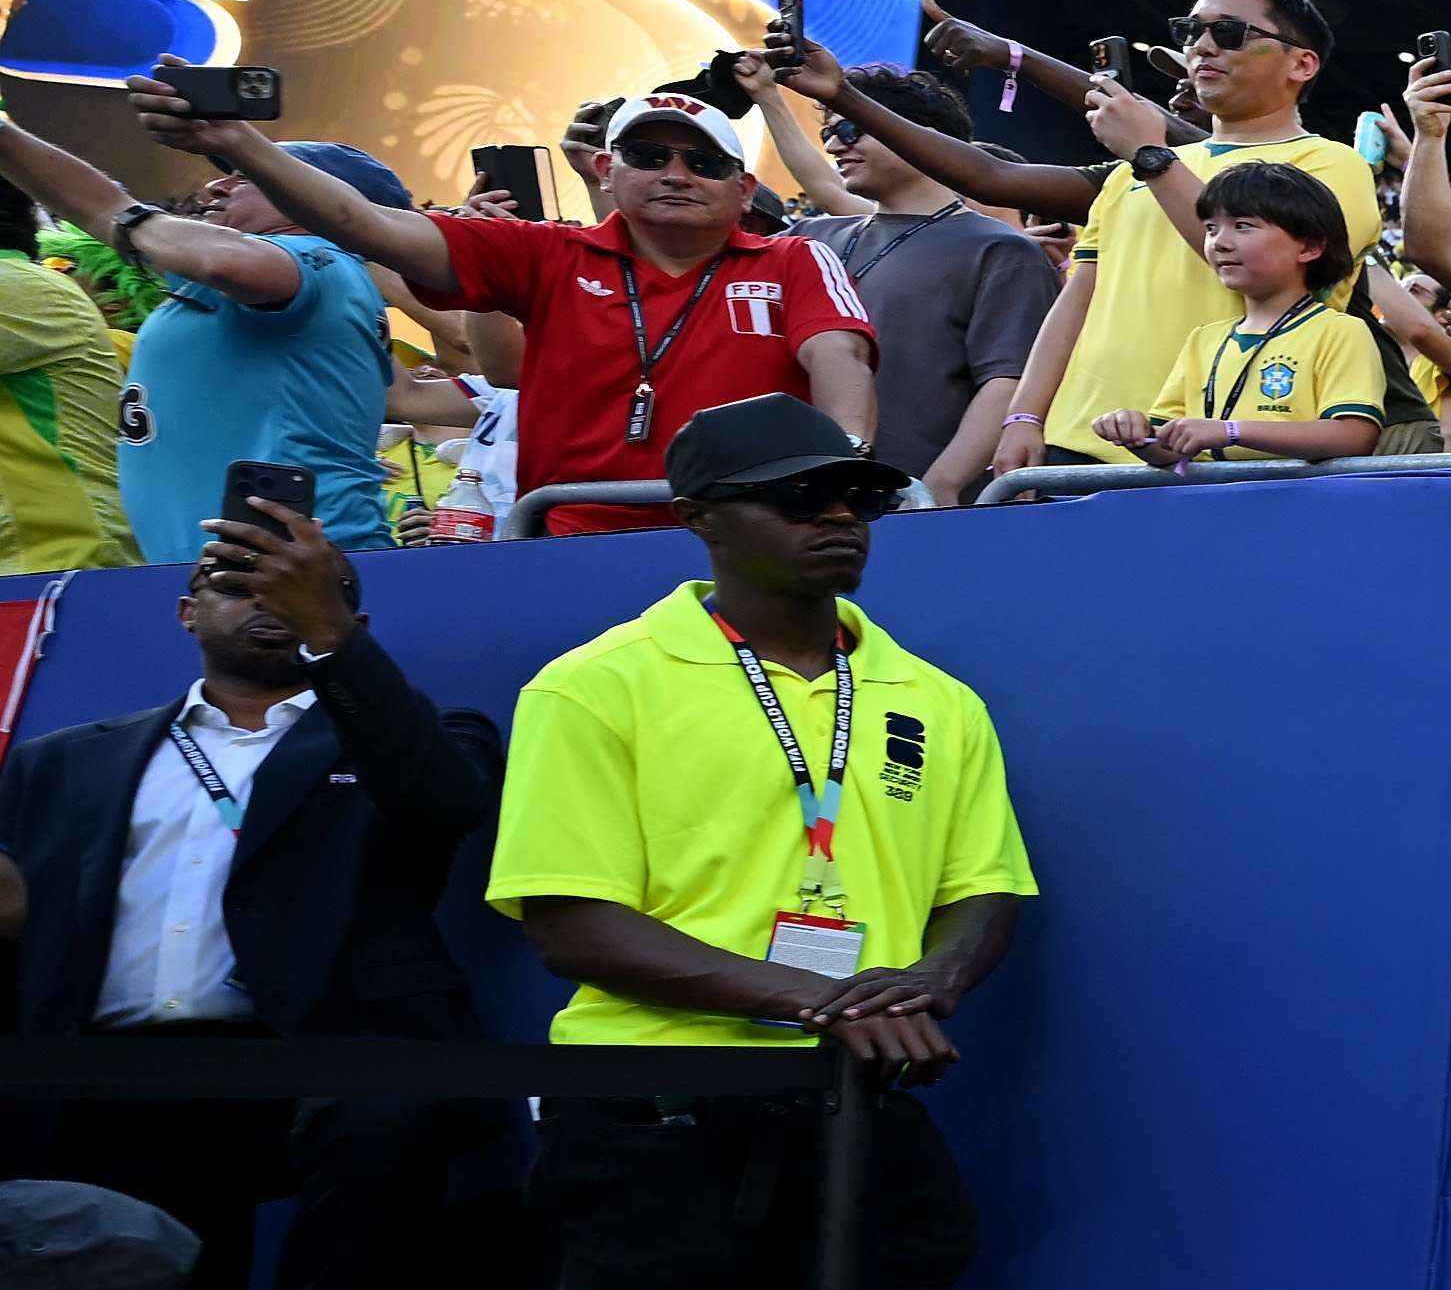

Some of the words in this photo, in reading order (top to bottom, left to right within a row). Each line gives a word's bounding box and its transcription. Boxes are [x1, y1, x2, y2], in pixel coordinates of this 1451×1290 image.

[732, 283, 779, 297] FPF
[1256, 404, 1292, 413] BRASIL
[838, 672, 853, 710] WORLD
[836, 709, 852, 732] CUP
